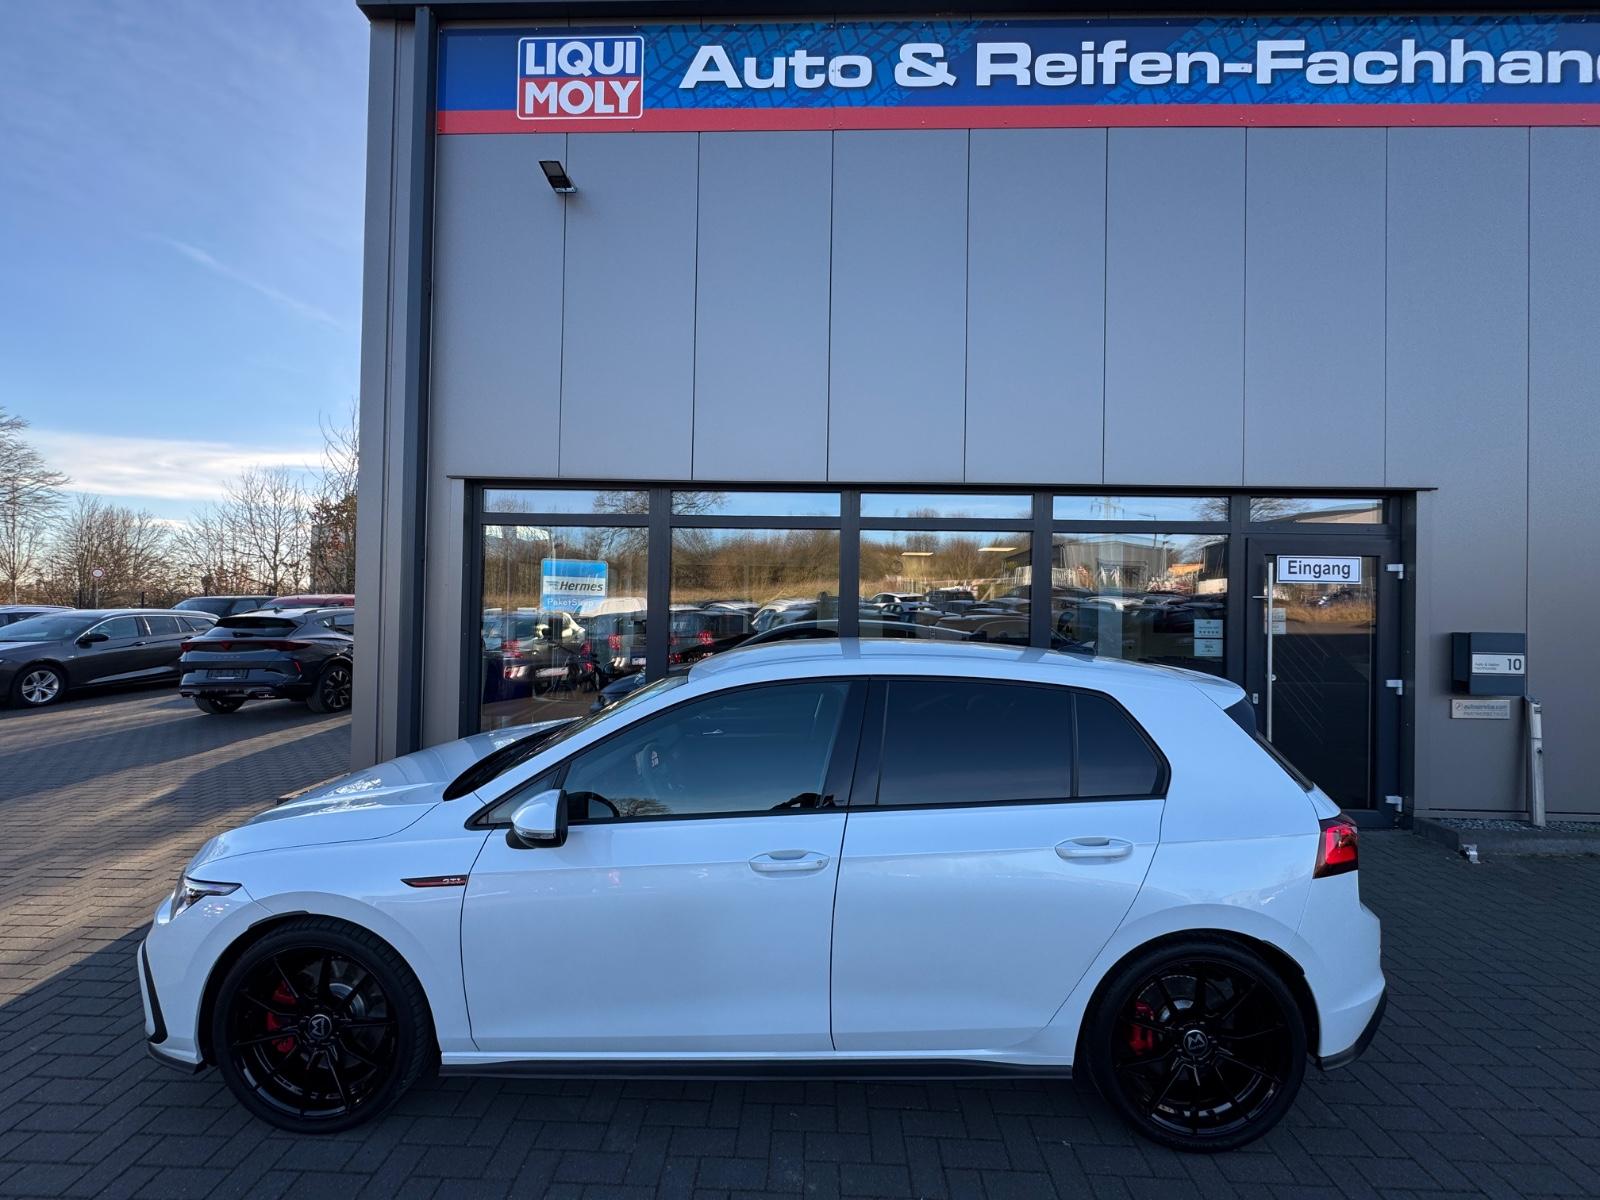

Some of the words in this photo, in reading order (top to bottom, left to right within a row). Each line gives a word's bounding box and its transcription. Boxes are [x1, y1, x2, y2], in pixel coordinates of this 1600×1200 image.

[525, 41, 636, 77] LIQUI
[678, 45, 872, 89] Auto
[894, 43, 957, 87] &
[976, 39, 1600, 87] Reifen-Fachhan
[525, 80, 640, 115] MOLY
[1287, 560, 1351, 579] Eingang
[559, 580, 604, 592] Hermes
[1507, 658, 1522, 671] 10
